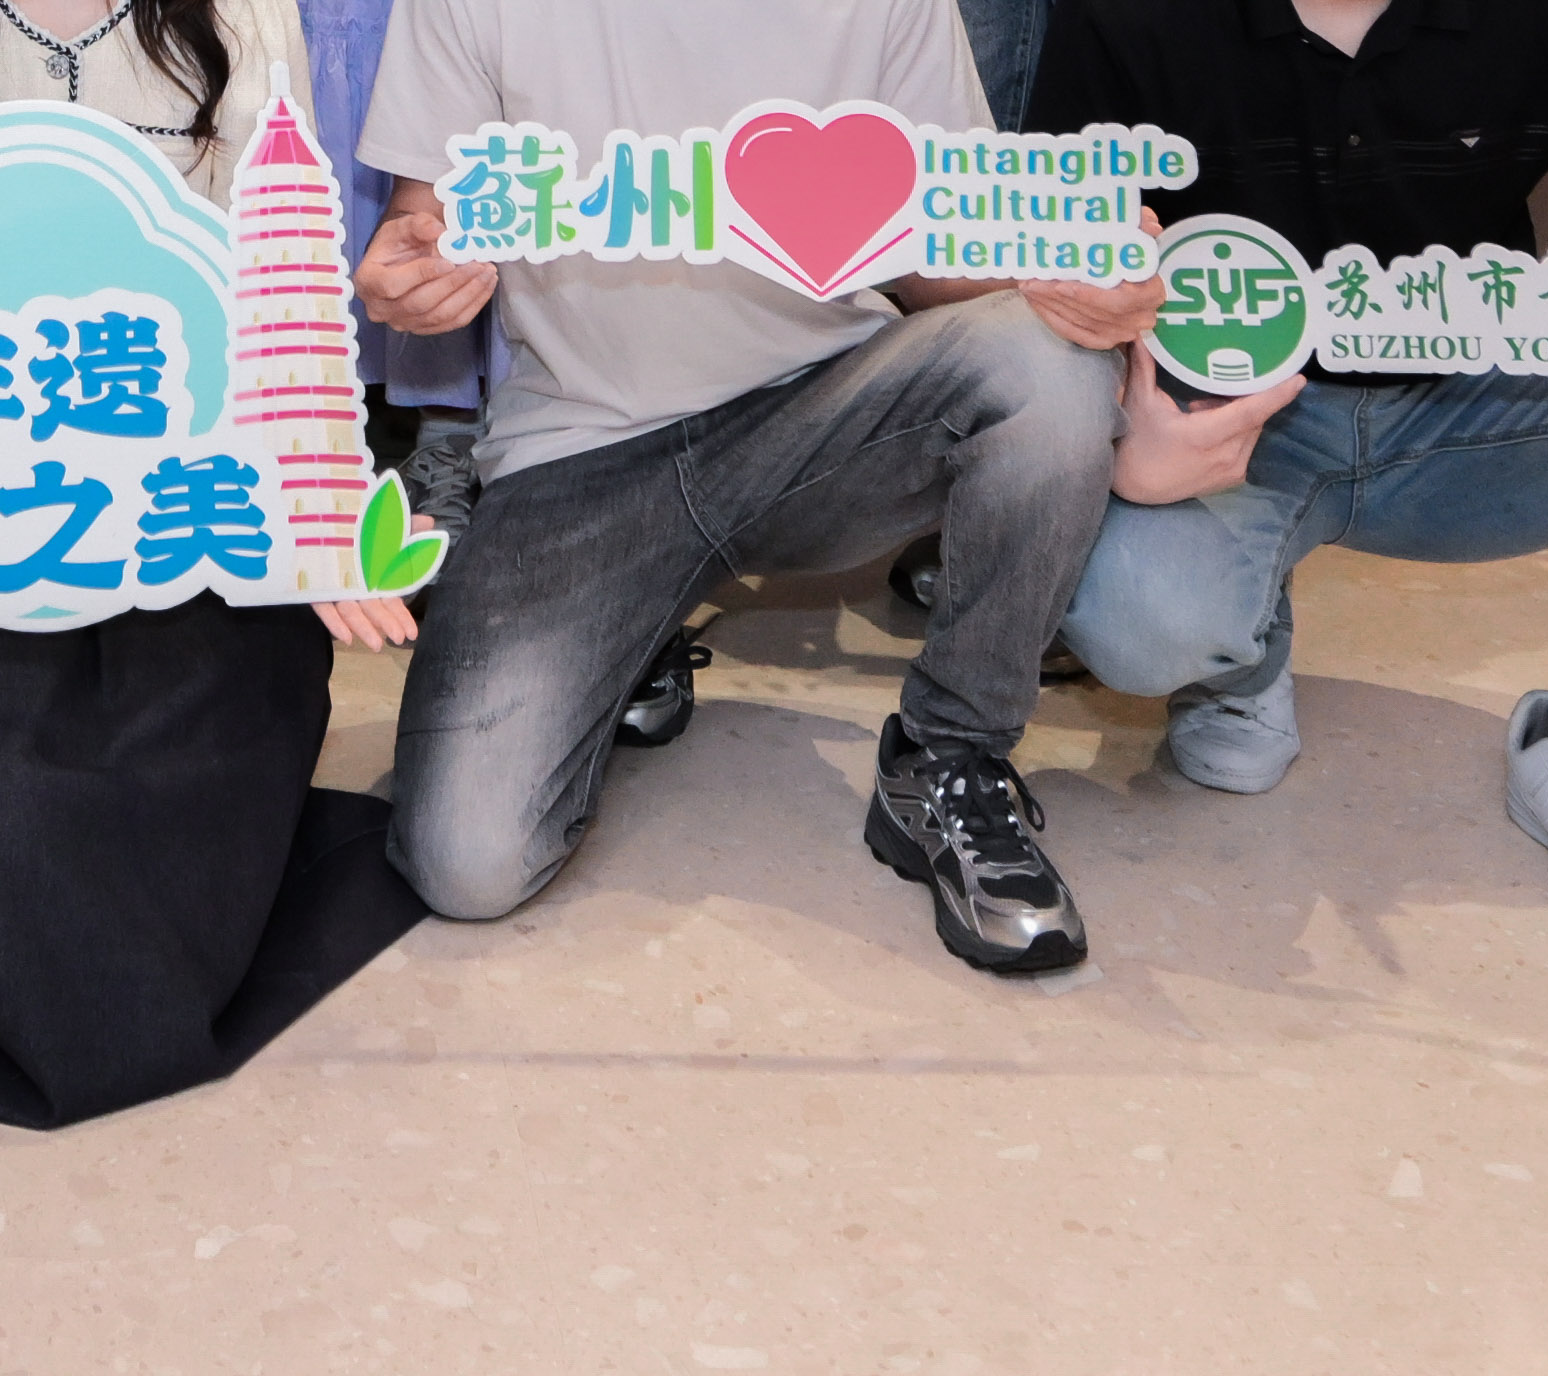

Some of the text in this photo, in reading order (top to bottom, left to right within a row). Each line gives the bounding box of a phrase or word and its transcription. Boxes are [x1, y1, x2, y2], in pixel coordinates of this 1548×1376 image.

[924, 138, 1186, 186] Intangible
[448, 135, 715, 250] 蘇州
[922, 186, 1128, 225] Cultural
[924, 232, 1148, 279] Heritage
[1331, 333, 1482, 362] SUZHOU
